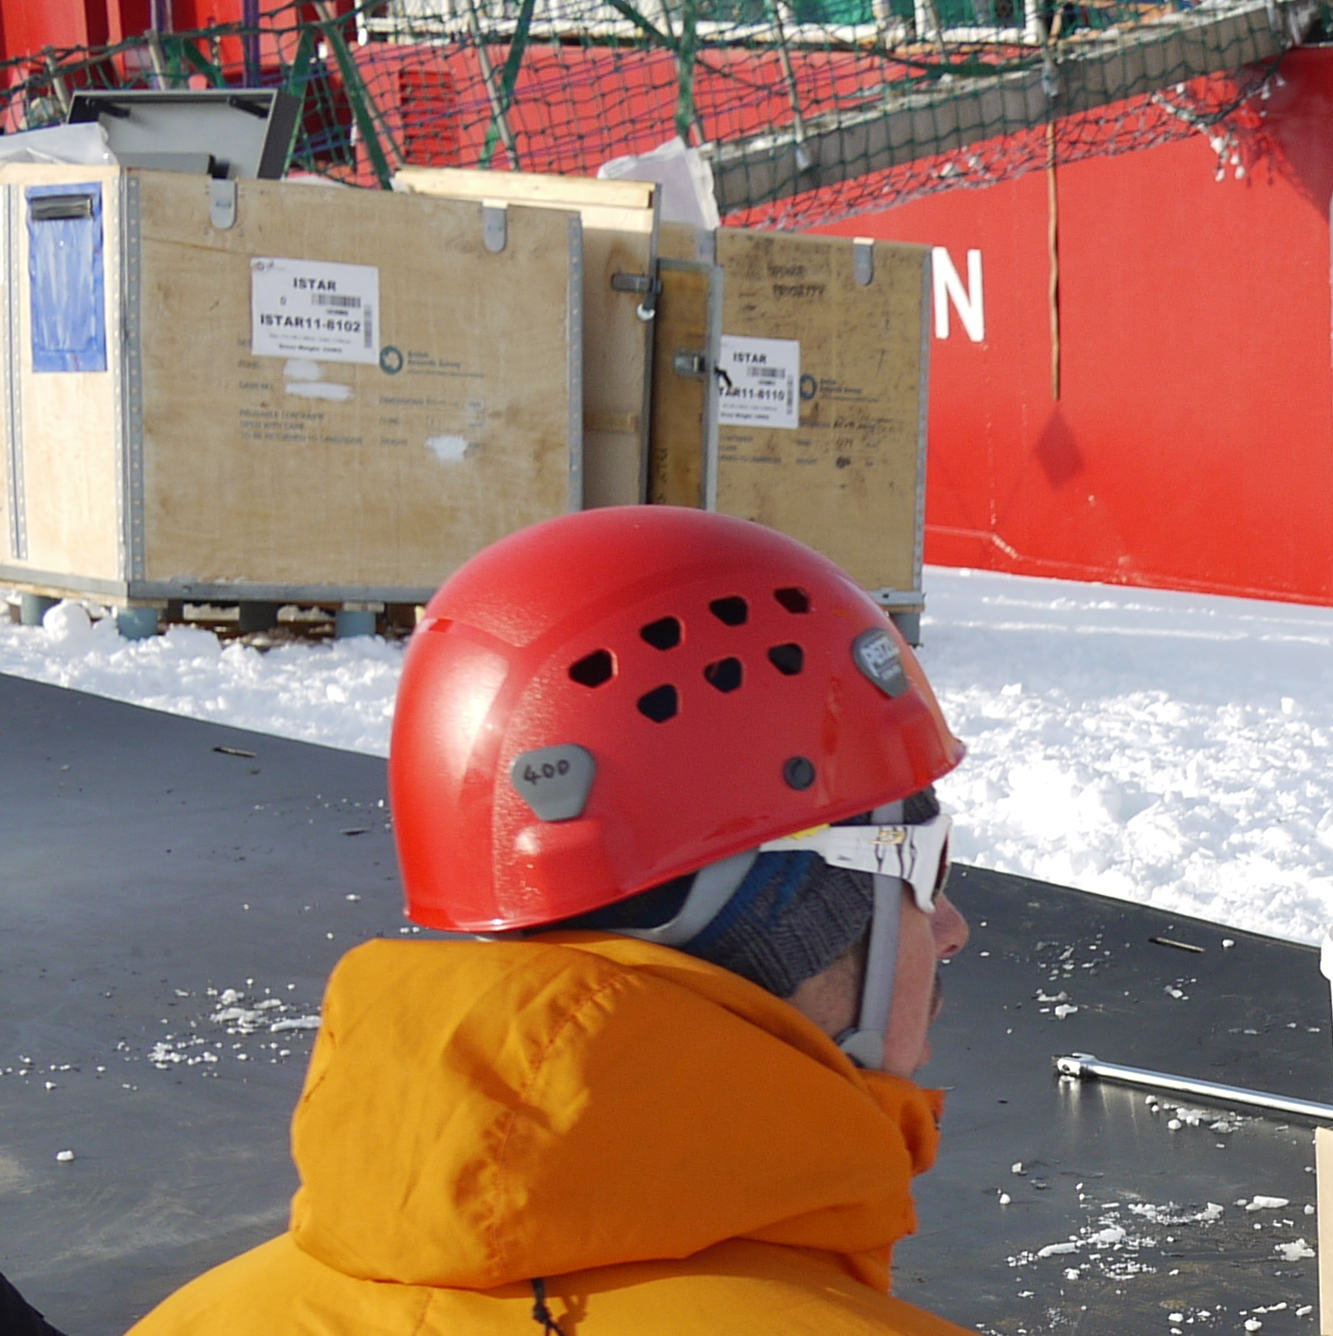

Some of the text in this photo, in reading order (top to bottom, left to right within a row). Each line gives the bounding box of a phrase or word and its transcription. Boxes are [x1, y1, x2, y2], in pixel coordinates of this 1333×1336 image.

[293, 277, 337, 292] ISTAR
[733, 352, 767, 364] ISTAR
[523, 759, 570, 786] 400
